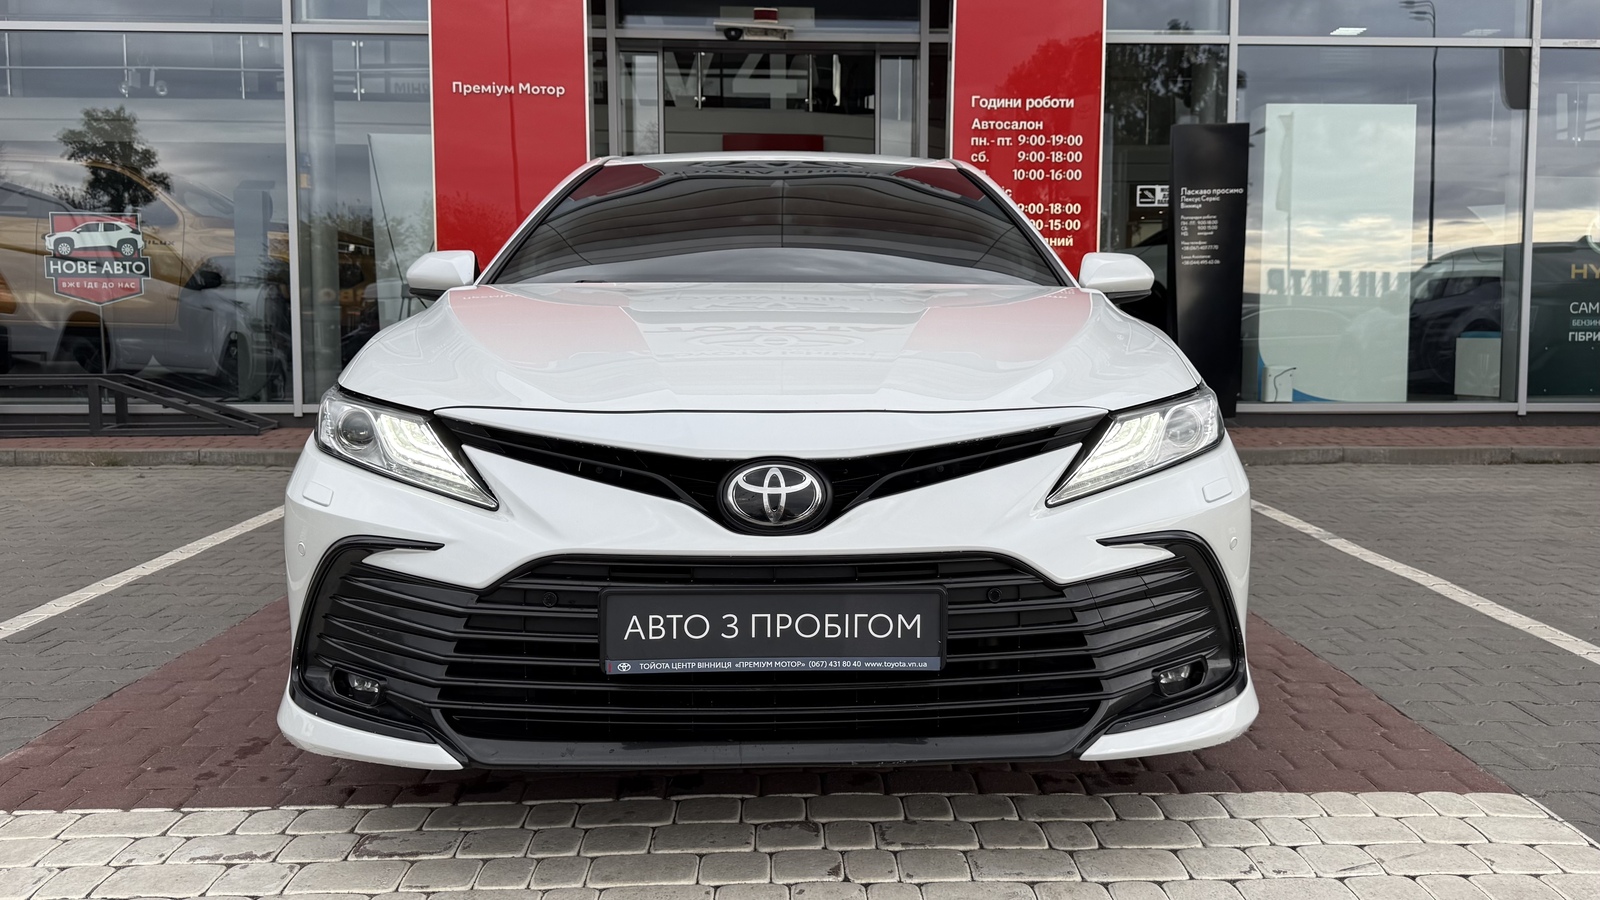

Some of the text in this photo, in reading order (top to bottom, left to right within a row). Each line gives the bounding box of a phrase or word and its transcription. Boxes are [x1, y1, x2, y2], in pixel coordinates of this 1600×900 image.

[452, 81, 566, 98] Преміум Мотор
[971, 95, 1075, 111] Години роботи
[971, 118, 1044, 130] Автосалон
[1018, 134, 1083, 147] 9:00-19:00
[970, 151, 1083, 163] сб. 9:00-18:00
[1012, 168, 1083, 181] 10:00-16:00
[1212, 187, 1244, 196] просимо
[1018, 203, 1082, 215] 9:00-18:00
[49, 260, 146, 274] НОВЕ АВТО
[83, 281, 99, 289] ЇДЕ
[623, 613, 710, 641] АВТО
[751, 613, 921, 639] ПРОБІГОМ
[639, 662, 671, 670] ТОЙОТА
[671, 662, 696, 670] ЦЕНТР
[697, 661, 732, 669] ВІННИЦЯ
[808, 660, 828, 669] (067)
[828, 660, 841, 668] 431
[842, 660, 852, 668] 80
[852, 660, 861, 668] 40
[864, 661, 928, 669] www.toyota.vn.ua
